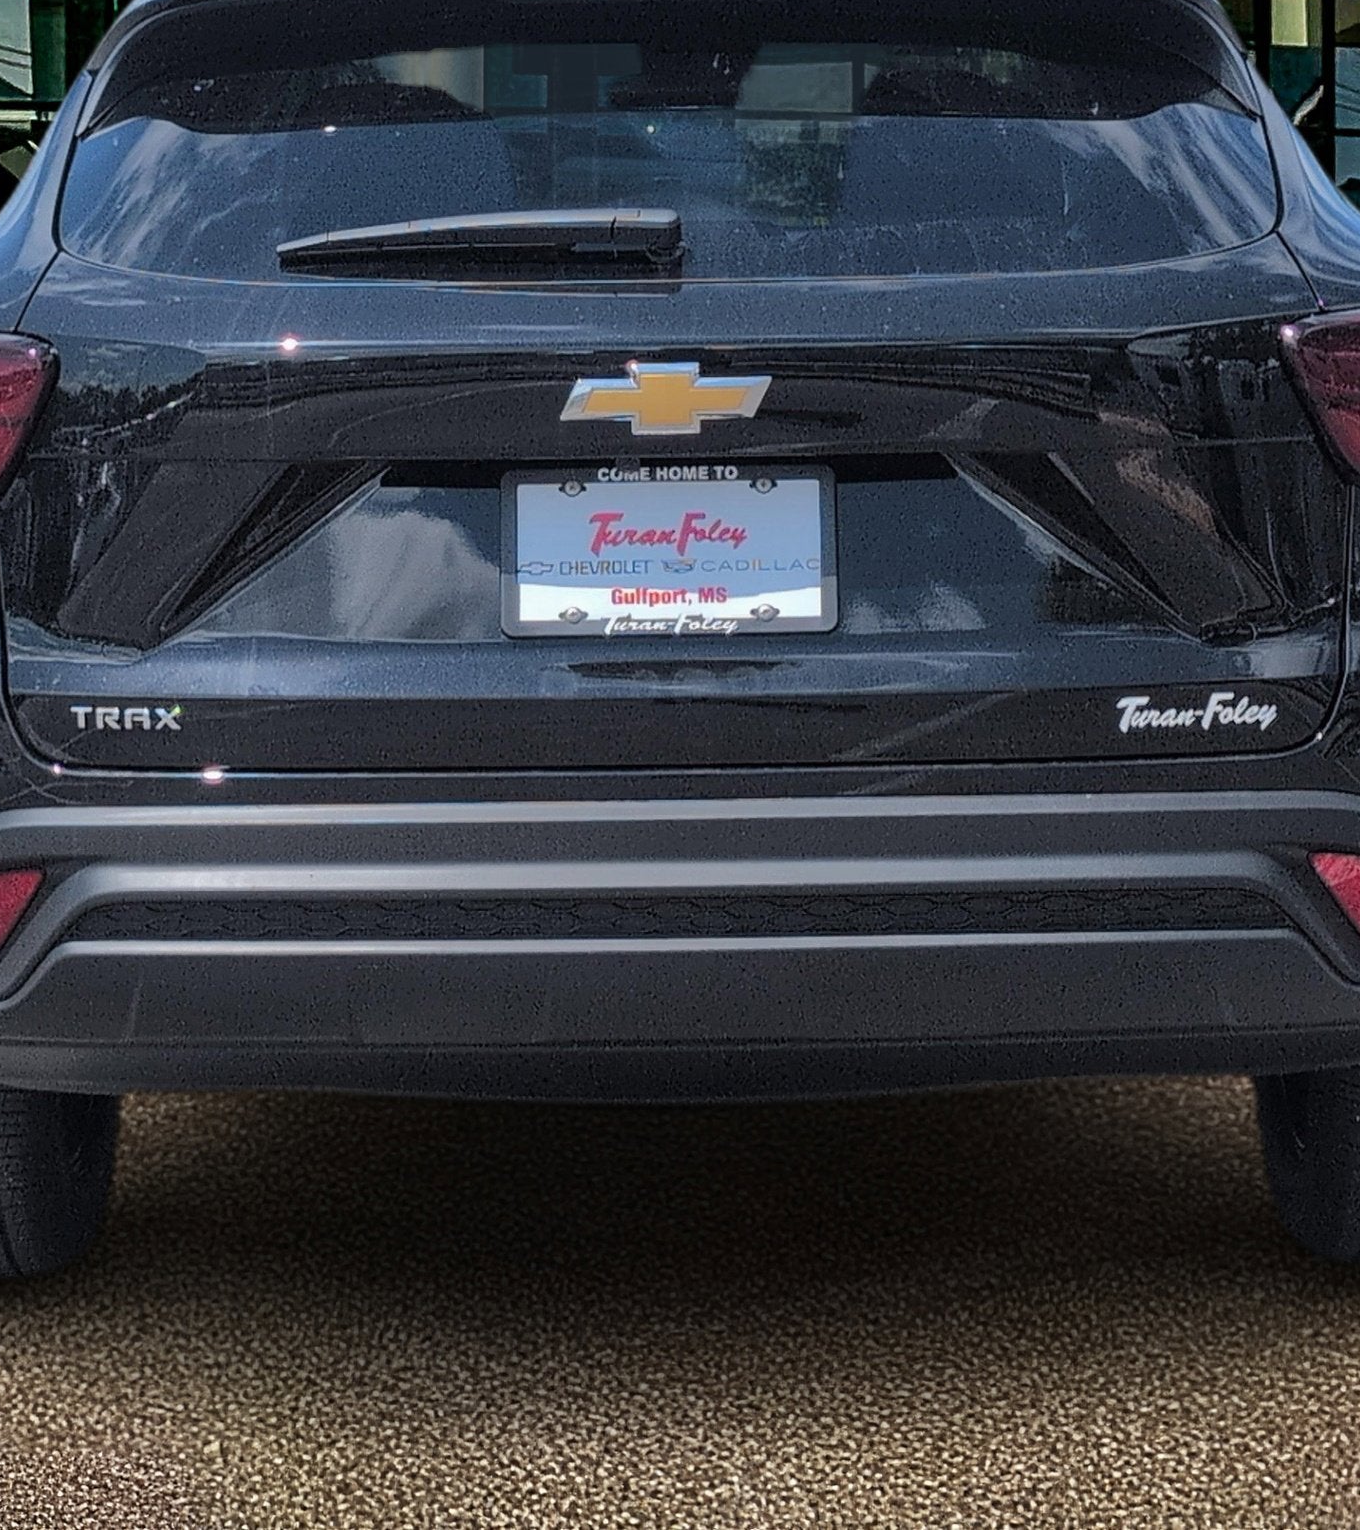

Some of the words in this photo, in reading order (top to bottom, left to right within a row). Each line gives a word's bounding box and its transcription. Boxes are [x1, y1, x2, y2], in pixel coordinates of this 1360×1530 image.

[597, 467, 651, 482] COME
[656, 466, 709, 481] HOME
[713, 465, 739, 480] TO
[589, 512, 677, 558] Turan
[676, 512, 747, 557] Foley
[559, 559, 653, 576] CHEVROLET
[699, 557, 821, 572] CADILLAC
[611, 587, 693, 607] Gulfport,
[698, 586, 728, 603] MS
[69, 705, 182, 731] TRAX
